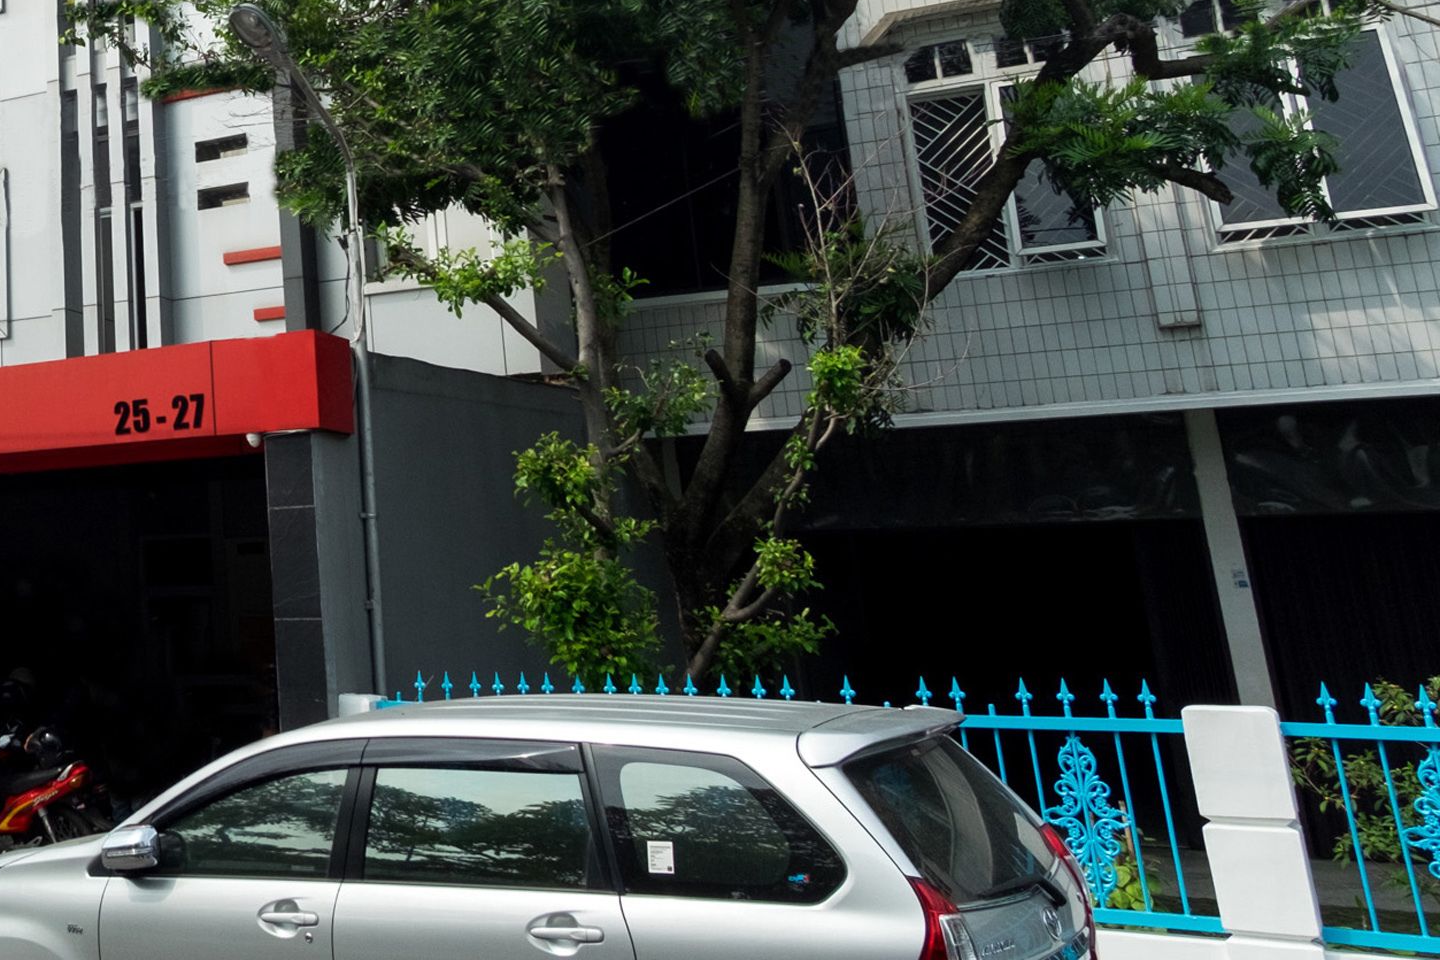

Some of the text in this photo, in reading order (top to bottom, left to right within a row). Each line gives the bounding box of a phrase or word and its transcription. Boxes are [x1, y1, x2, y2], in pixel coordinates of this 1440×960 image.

[114, 393, 205, 436] 25 - 27
